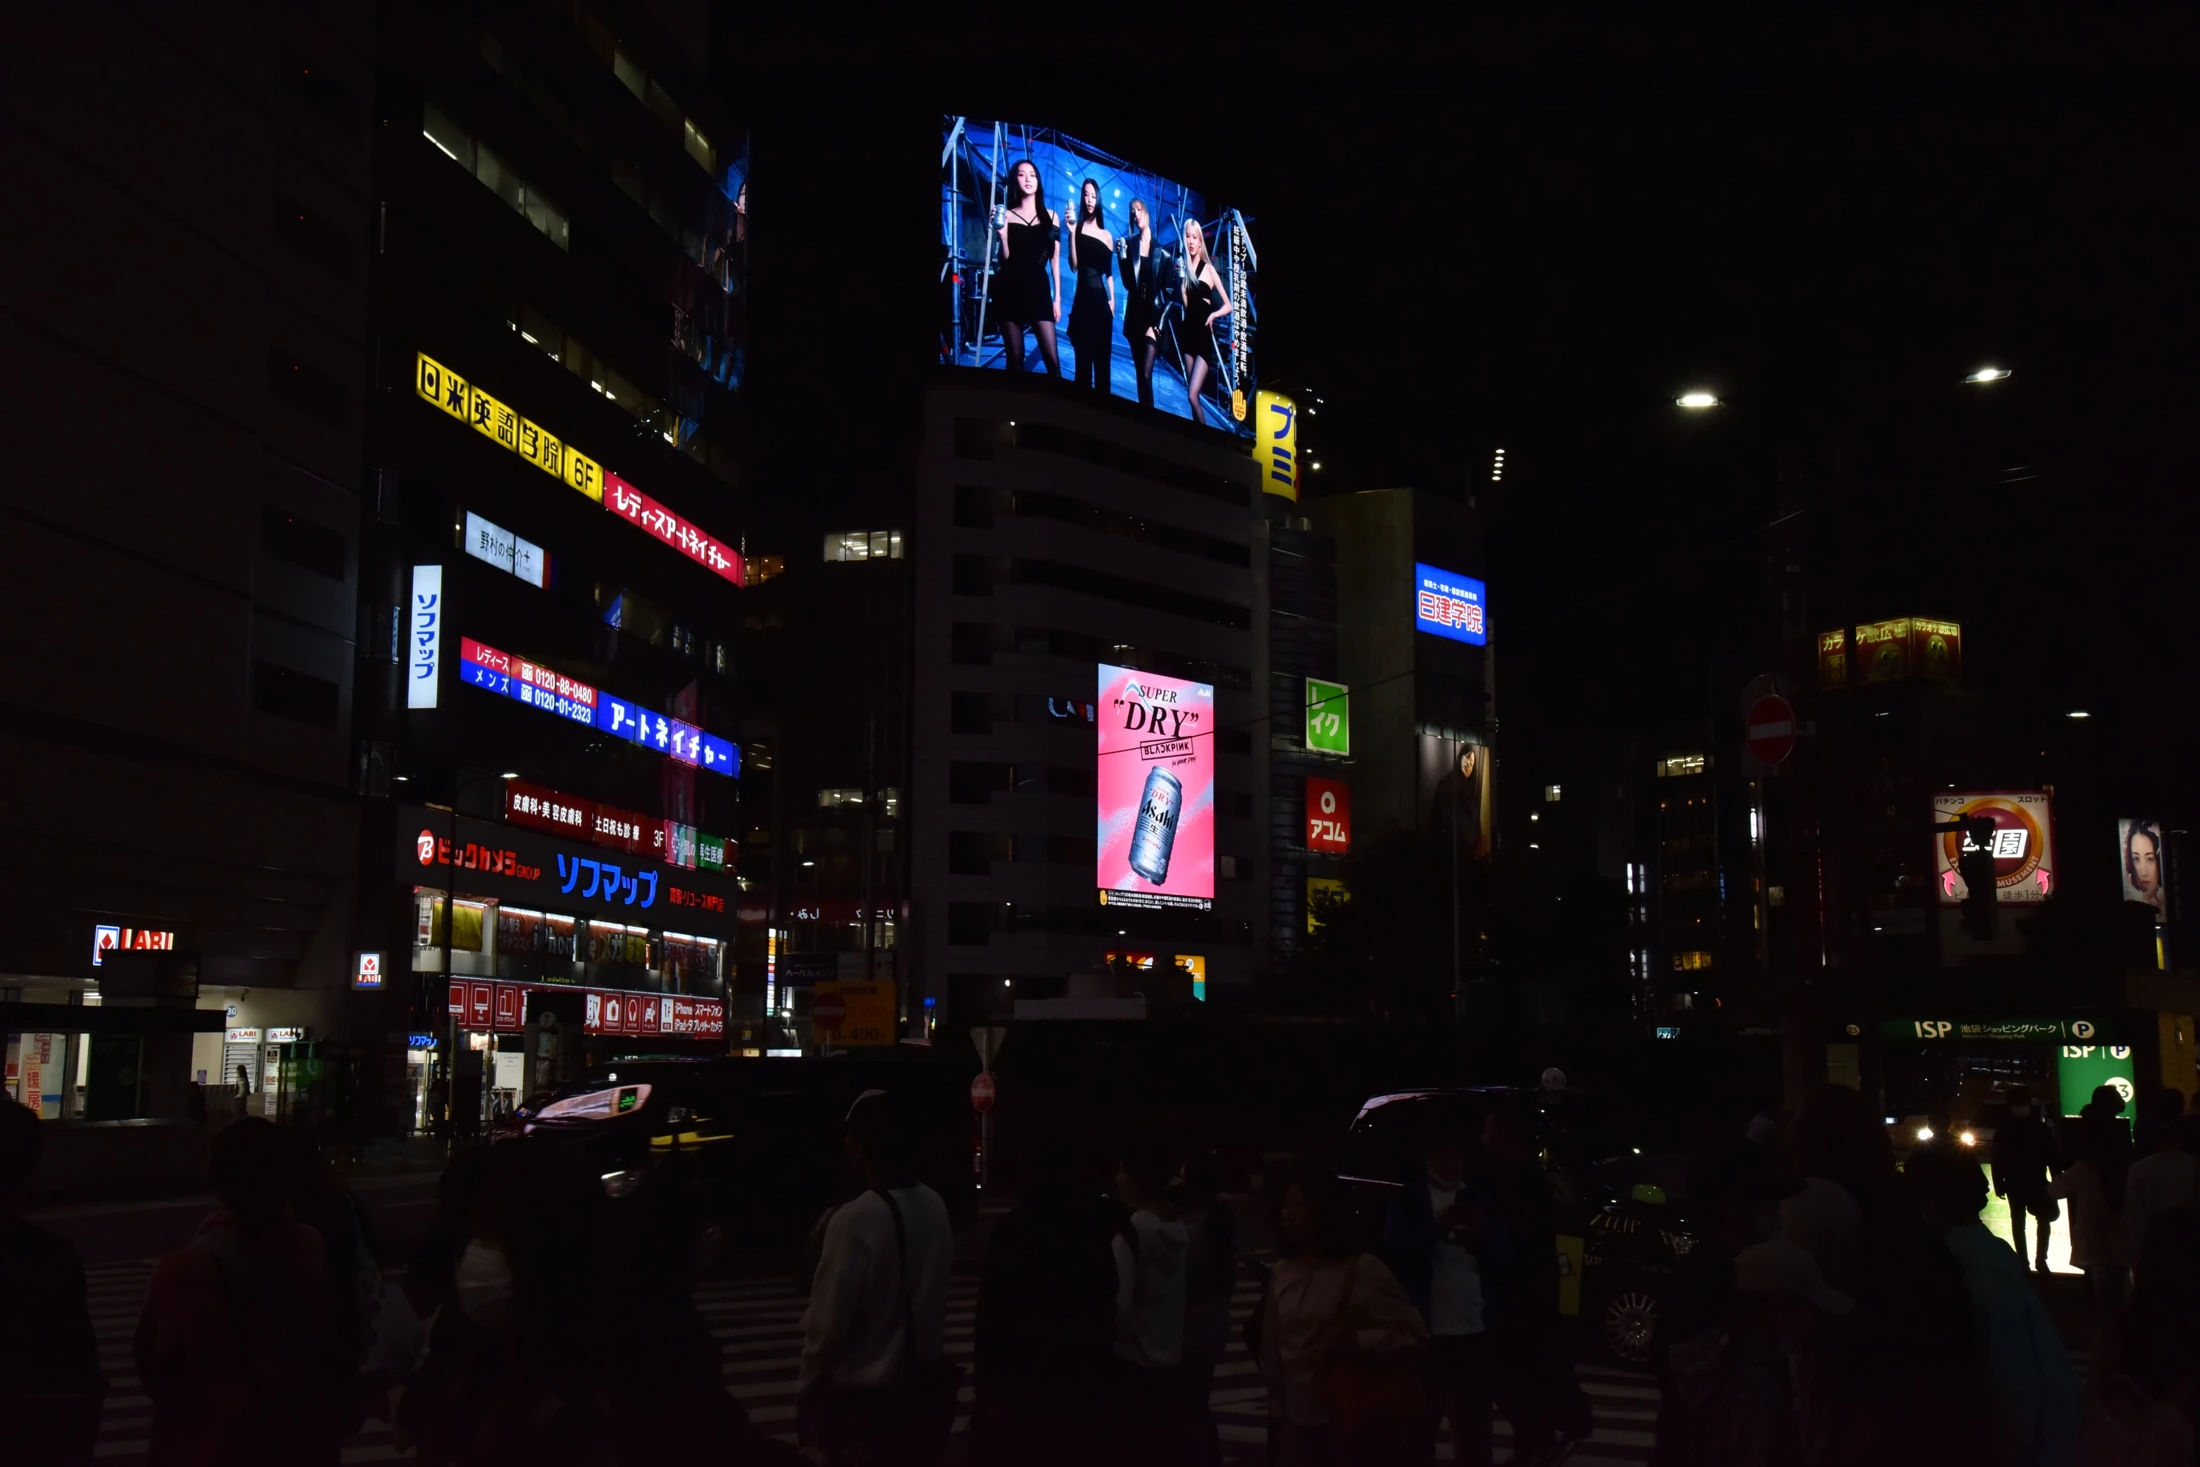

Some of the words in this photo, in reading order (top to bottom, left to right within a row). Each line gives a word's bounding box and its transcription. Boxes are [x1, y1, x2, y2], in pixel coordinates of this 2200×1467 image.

[421, 359, 559, 474] 日米英語学院
[574, 458, 594, 490] 6F
[612, 485, 731, 570] レディースアートネイチャー
[1419, 589, 1483, 634] 日建学院
[415, 594, 438, 679] ソフマップ
[477, 646, 510, 673] レディース
[535, 668, 593, 704] 0120-88-0480
[476, 670, 510, 693] メンズ
[534, 689, 592, 724] 0120-01-2323
[1139, 685, 1178, 703] SUPER
[611, 702, 727, 764] アートネイチャー
[1142, 799, 1175, 831] Asahi
[2017, 796, 2047, 804] スロット
[513, 794, 582, 826] 皮膚科・美容皮膚科
[595, 817, 640, 841] 土日祝も診療
[653, 830, 664, 847] 3F
[1311, 819, 1346, 842] アコム
[438, 838, 516, 877] ビックカメラ
[517, 864, 541, 880] GROUP
[1996, 855, 2039, 887] MUSEMENT
[557, 853, 658, 908] ソフマップ
[121, 928, 173, 950] LABI
[356, 974, 381, 982] LABI
[226, 1006, 237, 1016] 30
[675, 1002, 693, 1015] iPhone
[1915, 1021, 1952, 1039] ISP
[1961, 1024, 2057, 1034] 池袋ショッピングパーク
